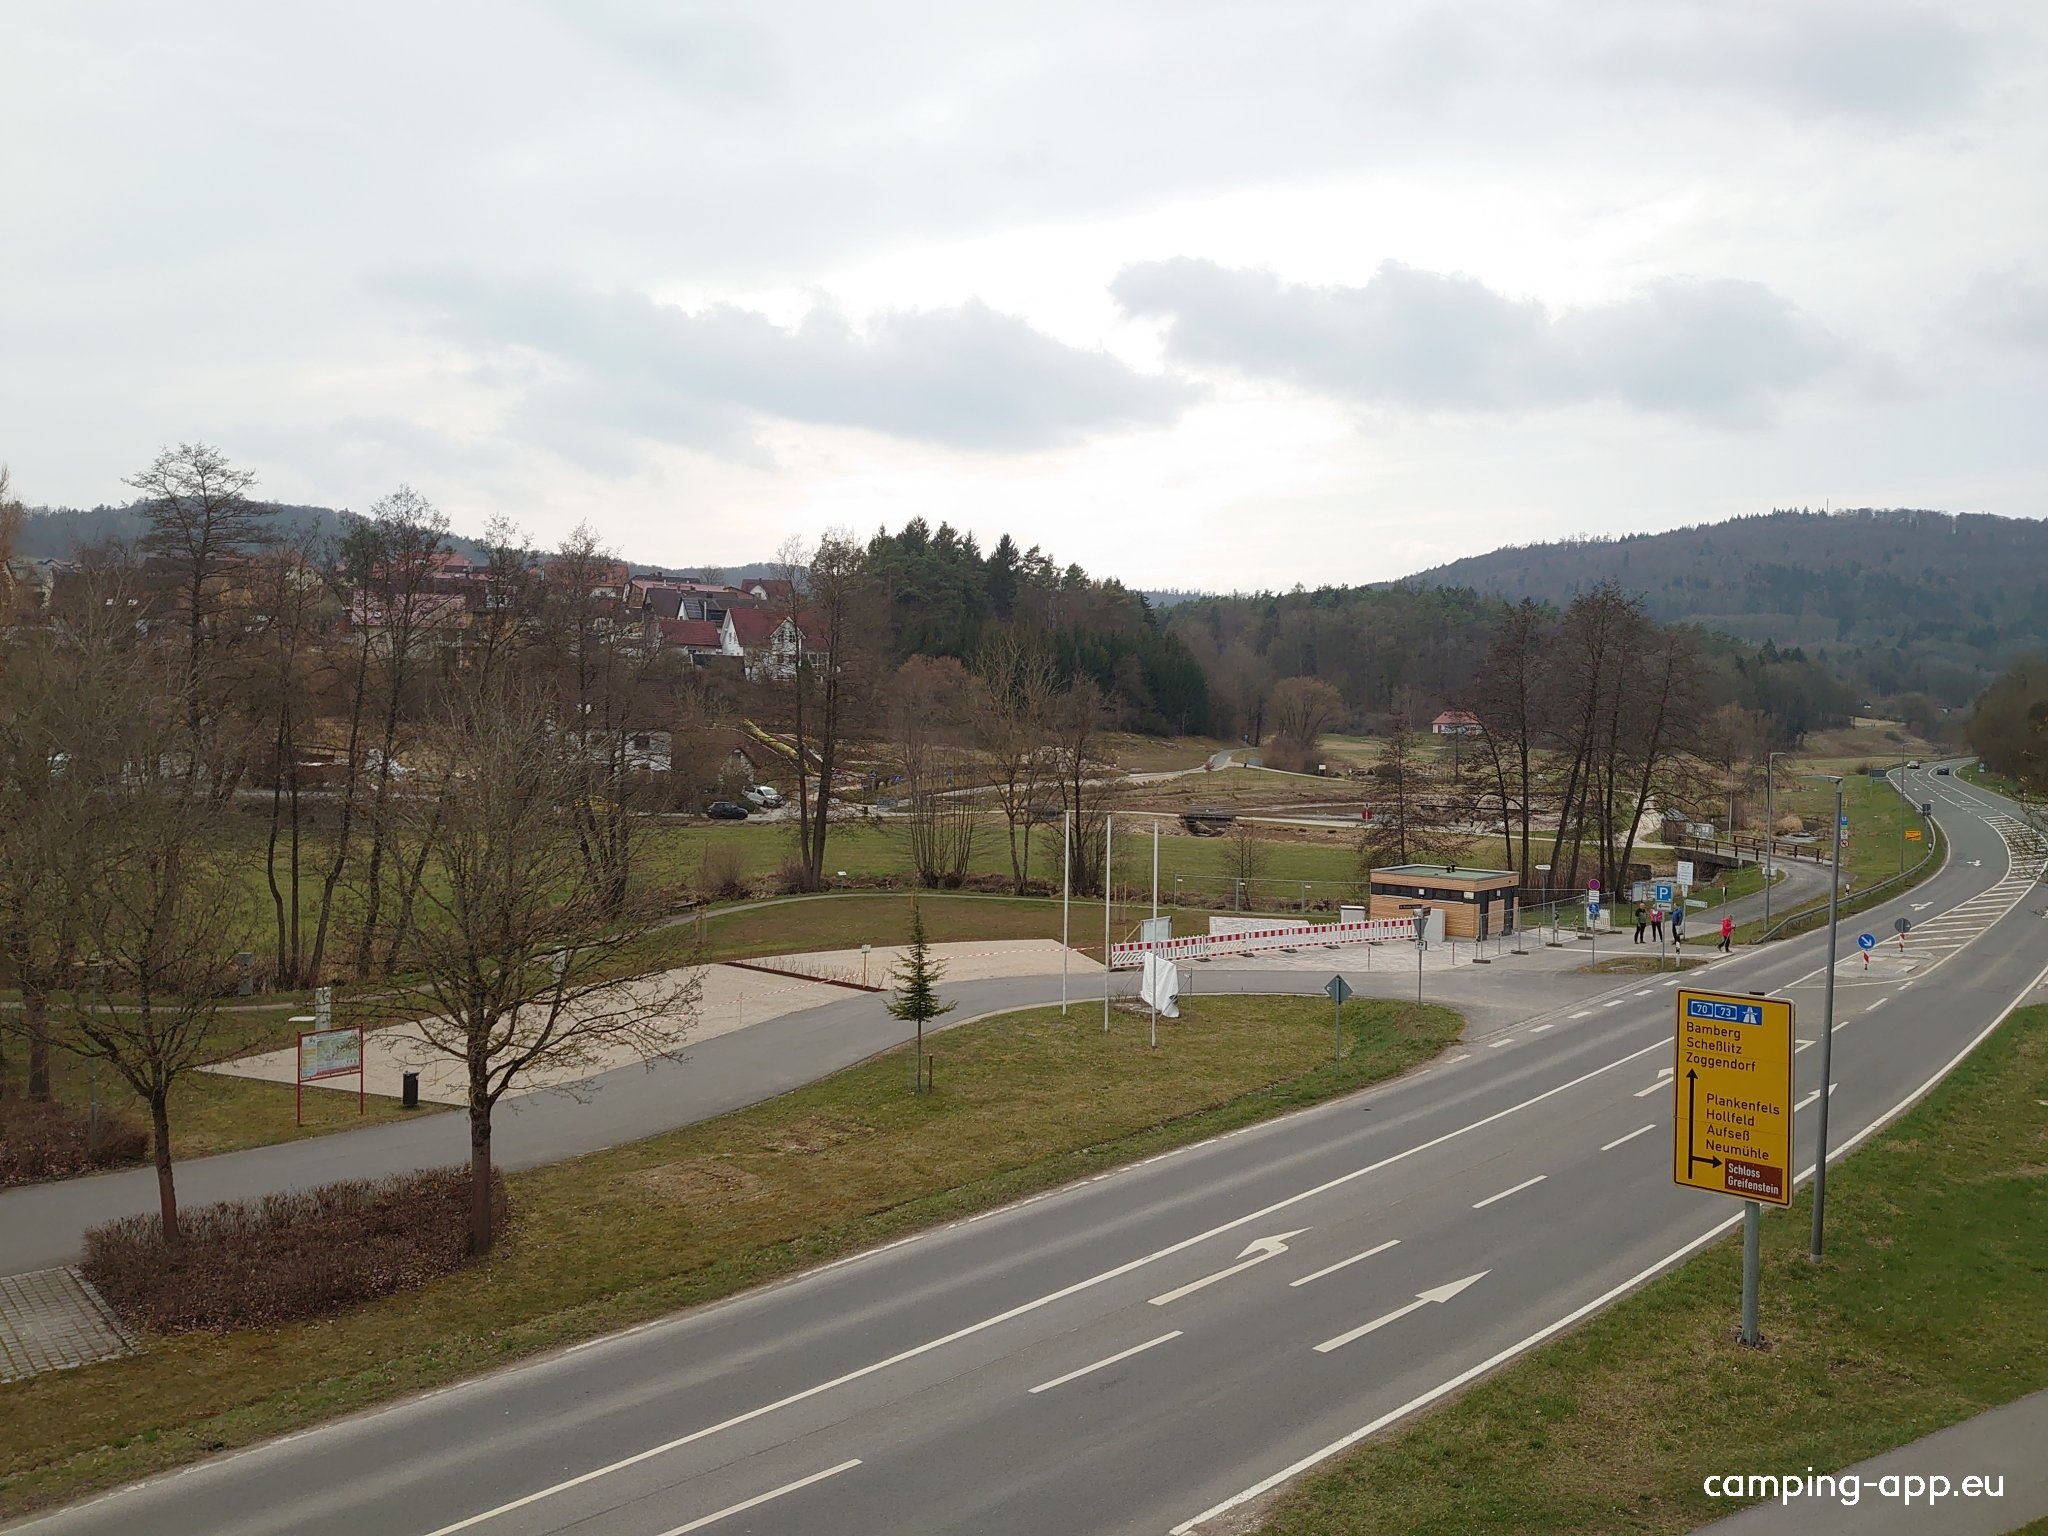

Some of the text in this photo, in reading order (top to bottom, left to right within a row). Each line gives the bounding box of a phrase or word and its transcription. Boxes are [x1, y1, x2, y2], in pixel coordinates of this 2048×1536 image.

[1660, 887, 1669, 899] P
[1697, 1004, 1731, 1017] 70 73
[1686, 1021, 1741, 1041] Bamberg
[1686, 1036, 1742, 1054] Scheßlitz
[1686, 1051, 1756, 1072] Zoggendorf
[1706, 1093, 1780, 1115] Plankenfels
[1706, 1109, 1755, 1127] Hollfeld
[1706, 1124, 1750, 1141] Aufseß
[1705, 1139, 1769, 1160] Neumühle
[1728, 1163, 1760, 1178] Schloss
[1727, 1175, 1779, 1195] Greifenstein
